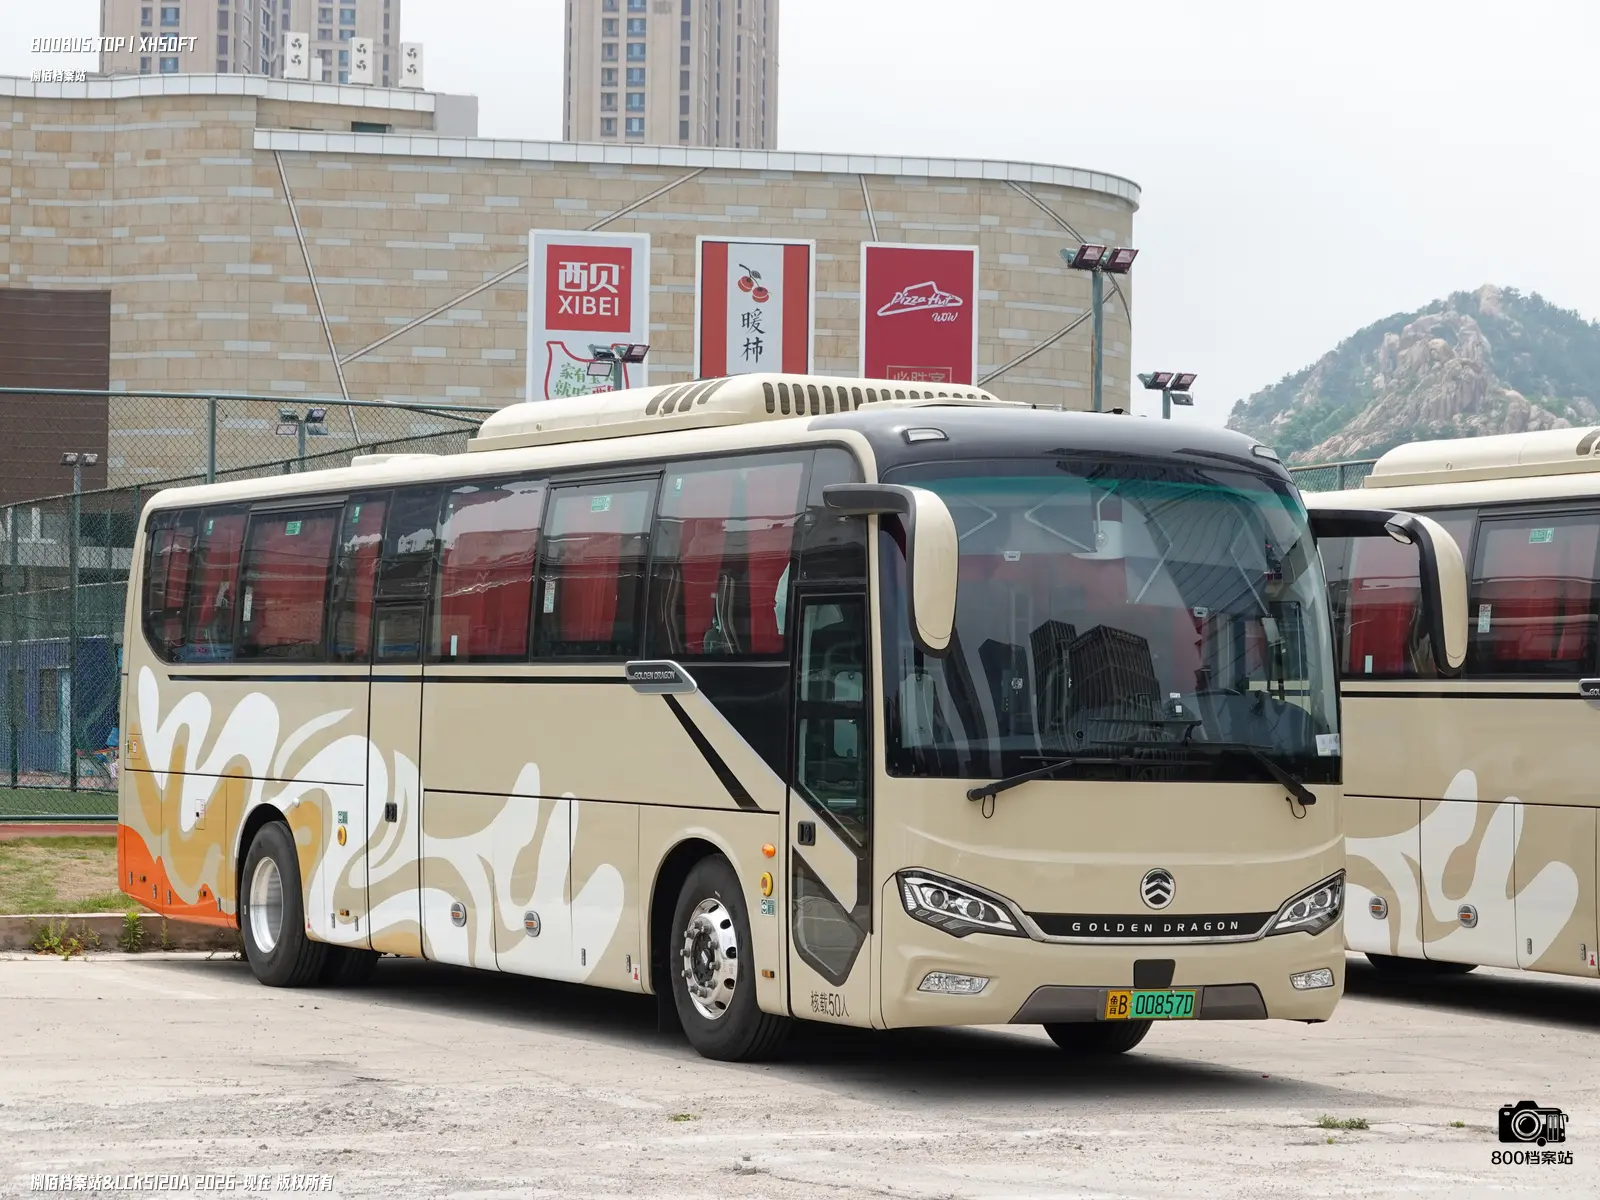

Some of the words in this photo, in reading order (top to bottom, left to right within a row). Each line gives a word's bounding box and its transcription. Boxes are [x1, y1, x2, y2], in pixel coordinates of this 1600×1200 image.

[558, 261, 619, 293] 西贝
[558, 295, 619, 316] XIBEI
[891, 291, 926, 306] Pizza
[927, 292, 953, 306] Hut
[741, 308, 766, 364] 暖柿
[634, 671, 654, 680] GOLDEN
[654, 670, 675, 680] DRAGON
[1072, 922, 1153, 932] GOLDEN
[1163, 921, 1239, 932] DRAGON
[810, 990, 850, 1017] 核载50人
[1109, 994, 1128, 1015] 鲁B
[1135, 994, 1194, 1015] 00857D
